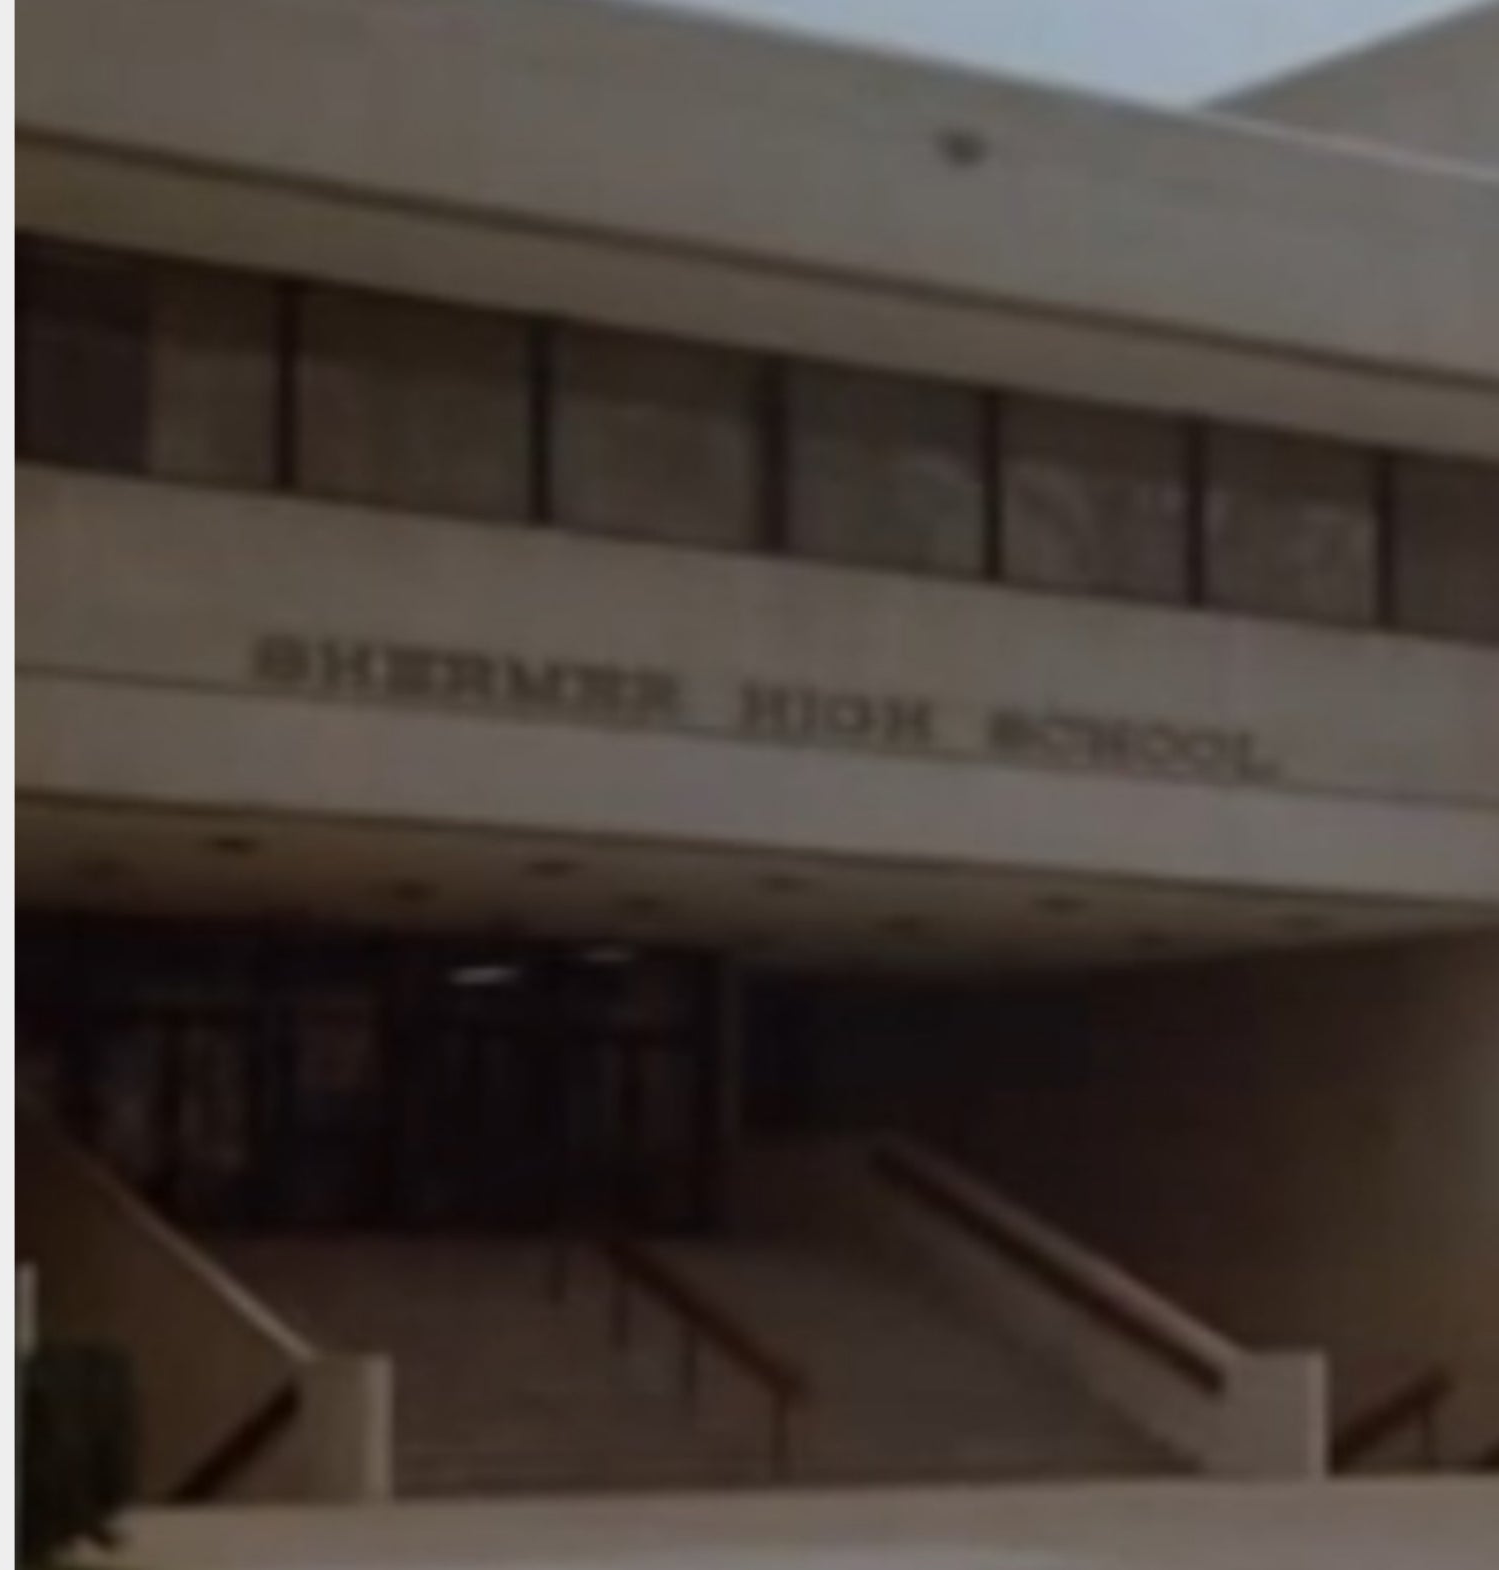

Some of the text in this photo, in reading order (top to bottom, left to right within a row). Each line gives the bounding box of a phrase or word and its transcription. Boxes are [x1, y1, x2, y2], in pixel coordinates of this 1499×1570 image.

[252, 633, 1281, 781] SHERMER HIGH SCHOOL
